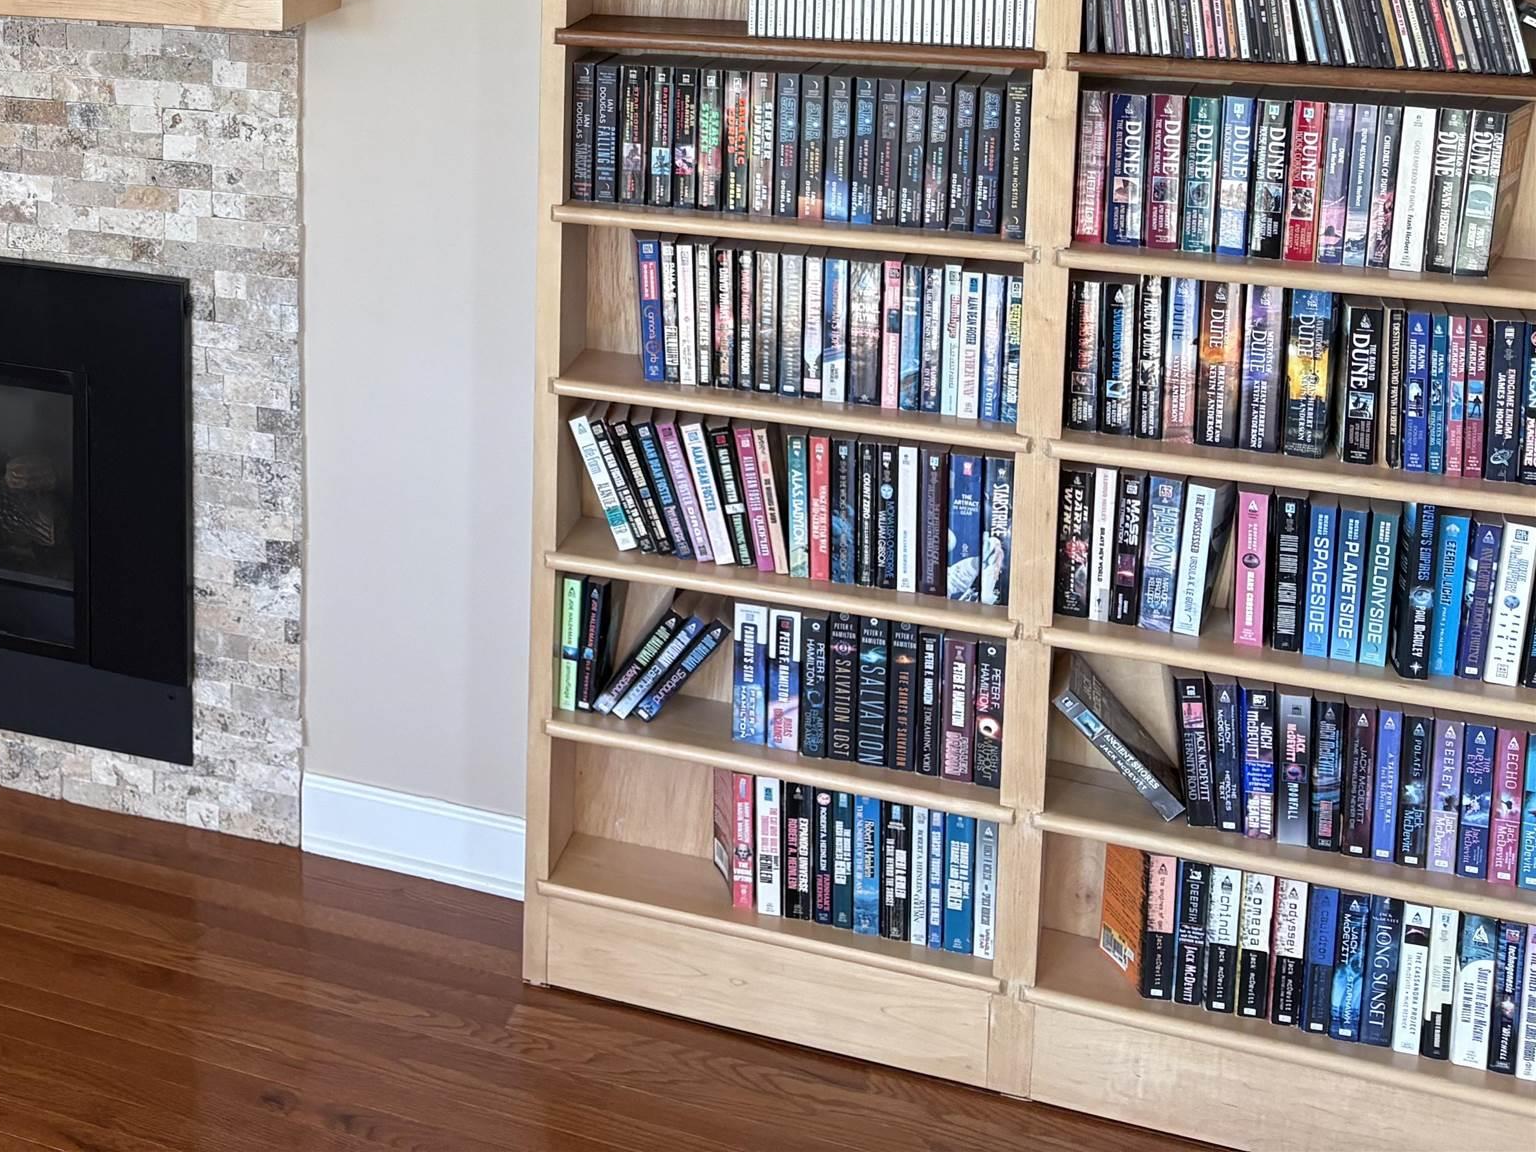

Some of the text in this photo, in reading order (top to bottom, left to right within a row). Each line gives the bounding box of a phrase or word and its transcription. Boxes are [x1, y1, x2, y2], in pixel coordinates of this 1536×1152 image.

[1456, 0, 1466, 19] GEES
[576, 102, 584, 138] DOUGLAS
[700, 103, 709, 153] STRIKE
[711, 111, 719, 147] STAR
[737, 97, 746, 166] GALACTIC
[753, 105, 763, 155] HUMAN
[763, 101, 773, 160] SEMPER
[1013, 116, 1021, 151] DOUGLAS
[597, 125, 610, 164] FALLING
[1124, 120, 1142, 175] DUNE
[1163, 120, 1181, 174] DUNE
[1195, 124, 1214, 179] DUNE
[1232, 125, 1250, 178] DUNE
[1267, 127, 1286, 180] DUNE
[1302, 132, 1319, 181] DUNE
[1469, 131, 1493, 177] DUNE
[1011, 178, 1019, 209] HOSTILES
[1437, 181, 1452, 245] FRANK HERBERT
[718, 268, 728, 292] DAVID
[967, 297, 978, 311] ALAN
[741, 270, 750, 375] DAVID THE WARRIOR
[966, 312, 978, 326] DEAN
[966, 327, 977, 345] FOSTER
[1250, 330, 1266, 373] DUNE
[1265, 331, 1274, 363] MENTATS
[1350, 333, 1370, 390] DUNE
[1369, 344, 1377, 355] THE
[1497, 373, 1505, 399] JAMES
[1505, 369, 1516, 440] ENDGAME ENIGMA
[1250, 409, 1259, 448] ANDERSON
[1258, 405, 1267, 437] HERBERT
[1495, 408, 1504, 435] HOGAN
[1524, 416, 1535, 467] MACHINE
[642, 439, 672, 505] ALAN DEAN FOSTER
[863, 473, 871, 519] COUNT ZERO
[791, 469, 804, 545] ALAS, BABYLON
[885, 501, 894, 521] MONA
[991, 483, 1009, 537] STARSTRIKE
[1063, 487, 1073, 535] WING
[1072, 488, 1082, 536] DARK
[1129, 498, 1141, 546] MASS
[1195, 494, 1206, 507] THE
[878, 511, 886, 567] WILLIAM GIBSON
[1148, 505, 1179, 573] HARMONY
[1190, 508, 1203, 553] DISPOSSESSED
[1418, 504, 1435, 581] EVENING'S EMPIRES
[885, 536, 894, 578] OVERDRIVE
[1188, 556, 1198, 580] URSULA
[1439, 540, 1457, 606] ETERNAL LIGHT
[1184, 596, 1194, 612] GUIN
[1309, 536, 1329, 635] SPACESIDE
[1338, 541, 1360, 639] PLANETSIDE
[1367, 544, 1390, 645] COLONYSIDE
[655, 626, 670, 640] JOE
[1411, 605, 1427, 658] PAUL McAULEY
[743, 666, 755, 683] STAR
[978, 663, 990, 712] HAMILTON
[991, 668, 1001, 700] PETER
[833, 659, 852, 757] SALVATION LOST
[858, 665, 886, 765] SALVATION
[896, 671, 910, 767] THE SAINTS OF SALVATION
[922, 711, 933, 772] DREAMING VOID
[976, 744, 984, 772] STARS
[1104, 733, 1160, 790] ANCIENT SHORES
[1285, 723, 1296, 763] McDEVITT
[1296, 734, 1306, 753] JACK
[1183, 732, 1198, 801] ETERNITY ROAD
[1195, 731, 1210, 802] JACK McDEVITT
[1351, 757, 1359, 793] TRAVELERS
[1357, 746, 1368, 824] JACK McDEVITT
[1505, 753, 1519, 790] ECHO
[1248, 798, 1261, 829] BEACH
[1259, 795, 1272, 835] INFINITY
[1287, 782, 1299, 820] MOONFALL
[1443, 814, 1456, 834] Jack
[788, 818, 798, 843] ROBERT
[1433, 816, 1445, 857] McDevitt
[787, 856, 798, 890] HEINLEIN
[798, 818, 809, 892] EXPANDED UNIVERSE
[819, 839, 828, 871] HEINLEIN
[1188, 883, 1199, 923] DEEPSIX
[1218, 895, 1232, 942] chindi
[1249, 897, 1263, 946] omega
[1286, 903, 1298, 954] odyssey
[1343, 975, 1353, 1024] STARHAWK
[1368, 925, 1392, 1028] LONG SUNSET
[1409, 952, 1423, 1035] THE CASSANDRA PROJECT
